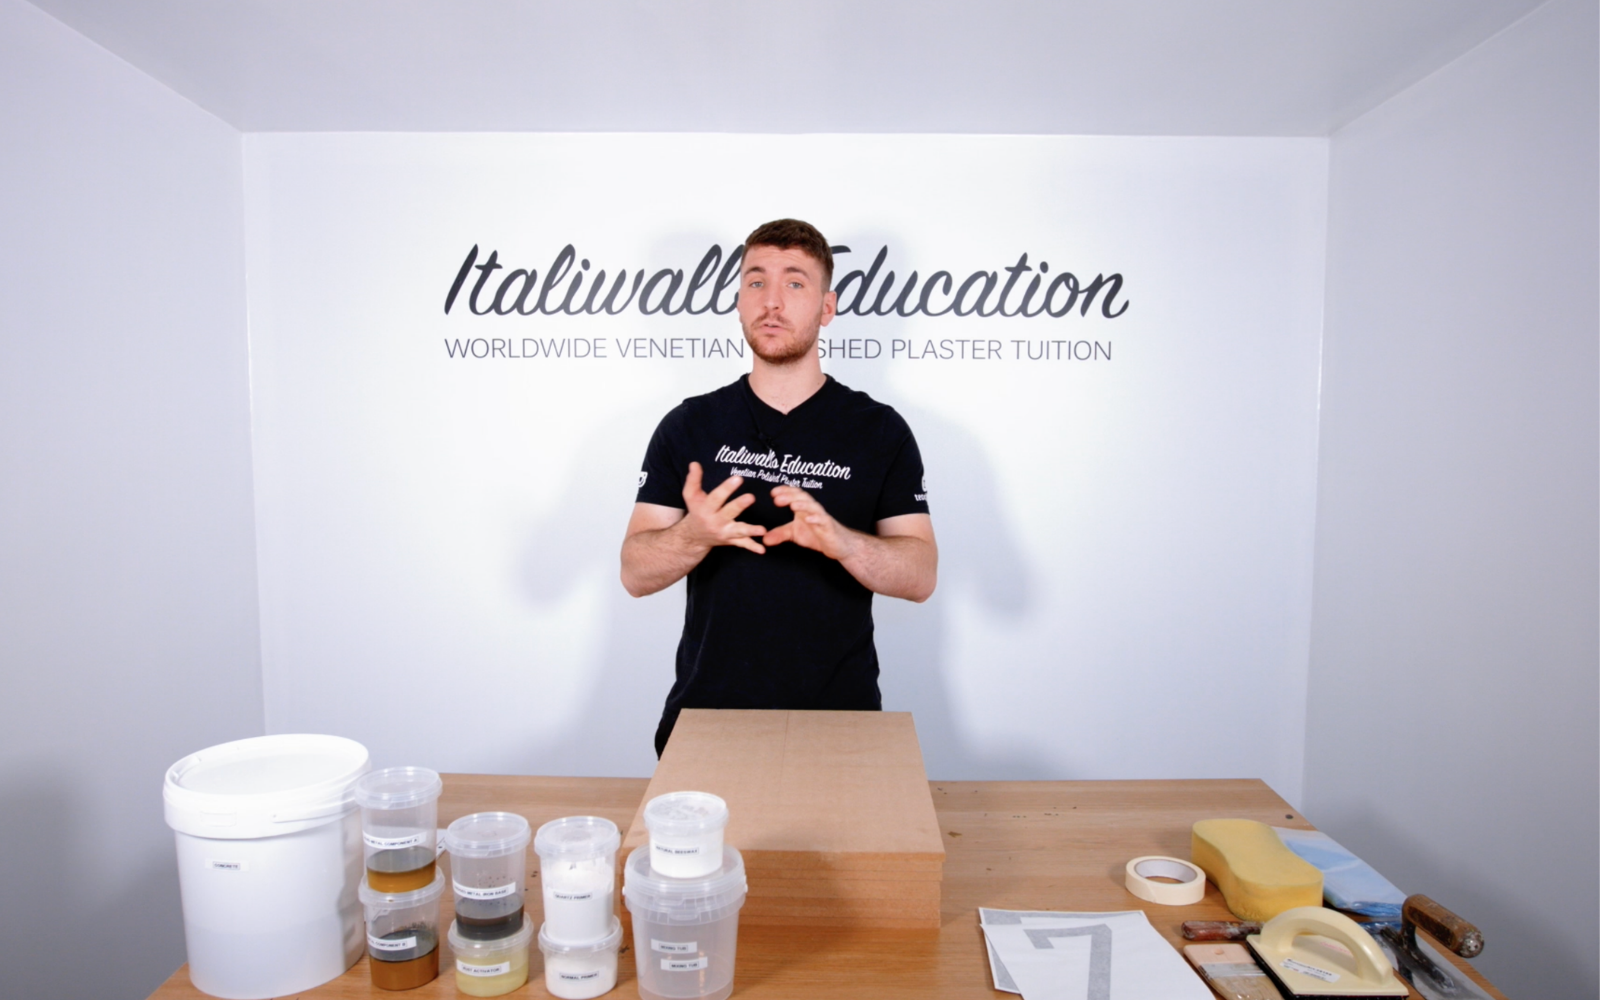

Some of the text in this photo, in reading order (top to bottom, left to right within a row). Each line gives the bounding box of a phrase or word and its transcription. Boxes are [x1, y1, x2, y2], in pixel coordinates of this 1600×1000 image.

[444, 243, 744, 316] Italiwall
[444, 338, 1112, 361] WORLDWIDE VENETIAN SHED PLASTER TUITION
[780, 454, 851, 480] Education
[801, 477, 823, 489] Tuition
